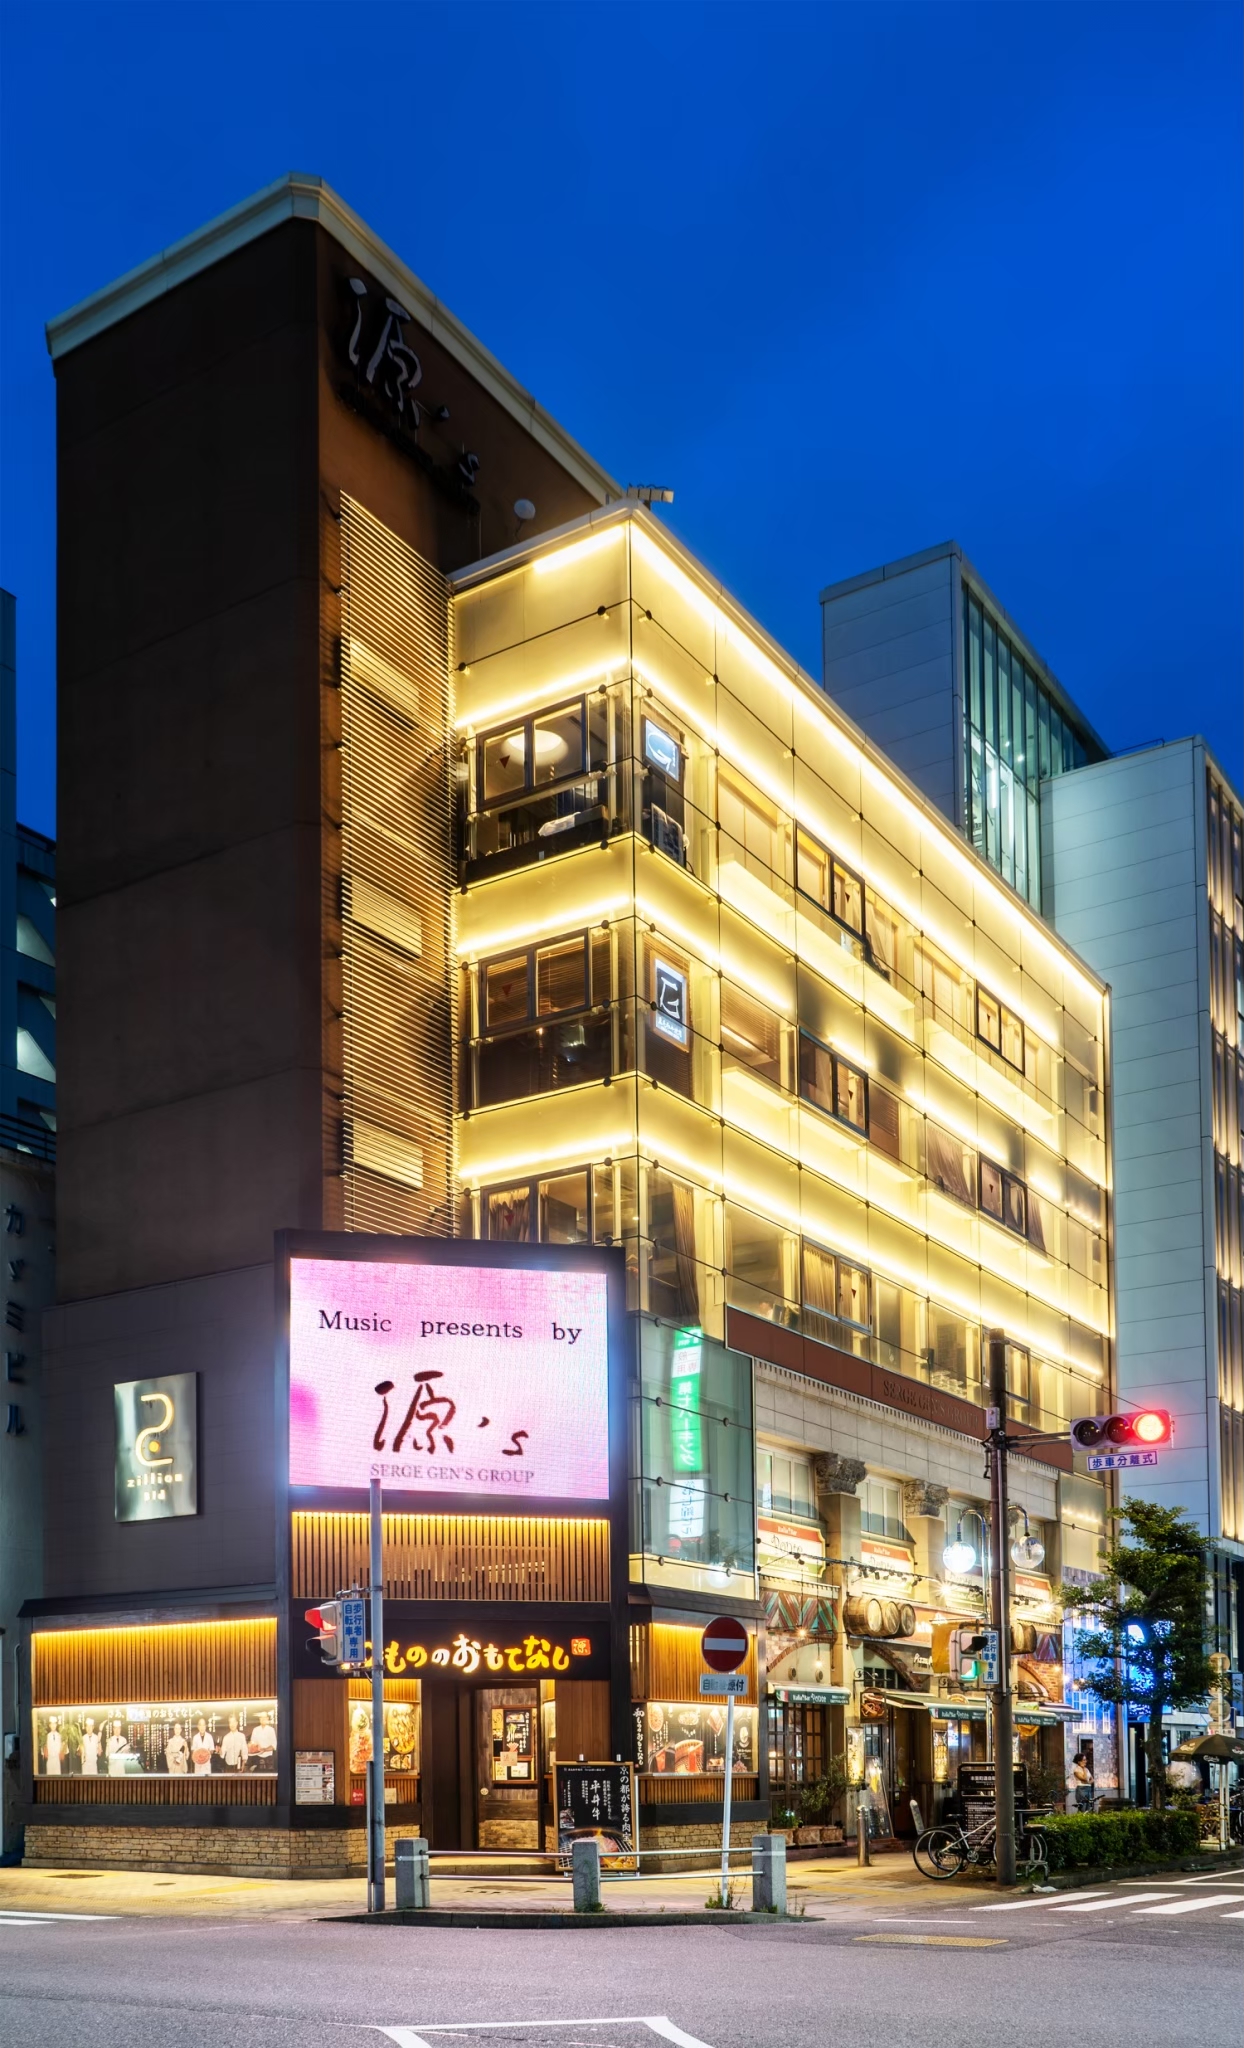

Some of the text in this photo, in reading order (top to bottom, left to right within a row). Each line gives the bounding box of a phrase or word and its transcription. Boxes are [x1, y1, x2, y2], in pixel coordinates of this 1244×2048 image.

[318, 1309, 583, 1344] Music presents by
[883, 1380, 917, 1407] SERGE
[370, 1463, 535, 1484] SERGE GEN'S GROUP
[1092, 1454, 1153, 1469] 歩車分離式
[344, 1603, 354, 1636] 自転車
[353, 1603, 363, 1636] 歩行者
[349, 1637, 359, 1659] 専用
